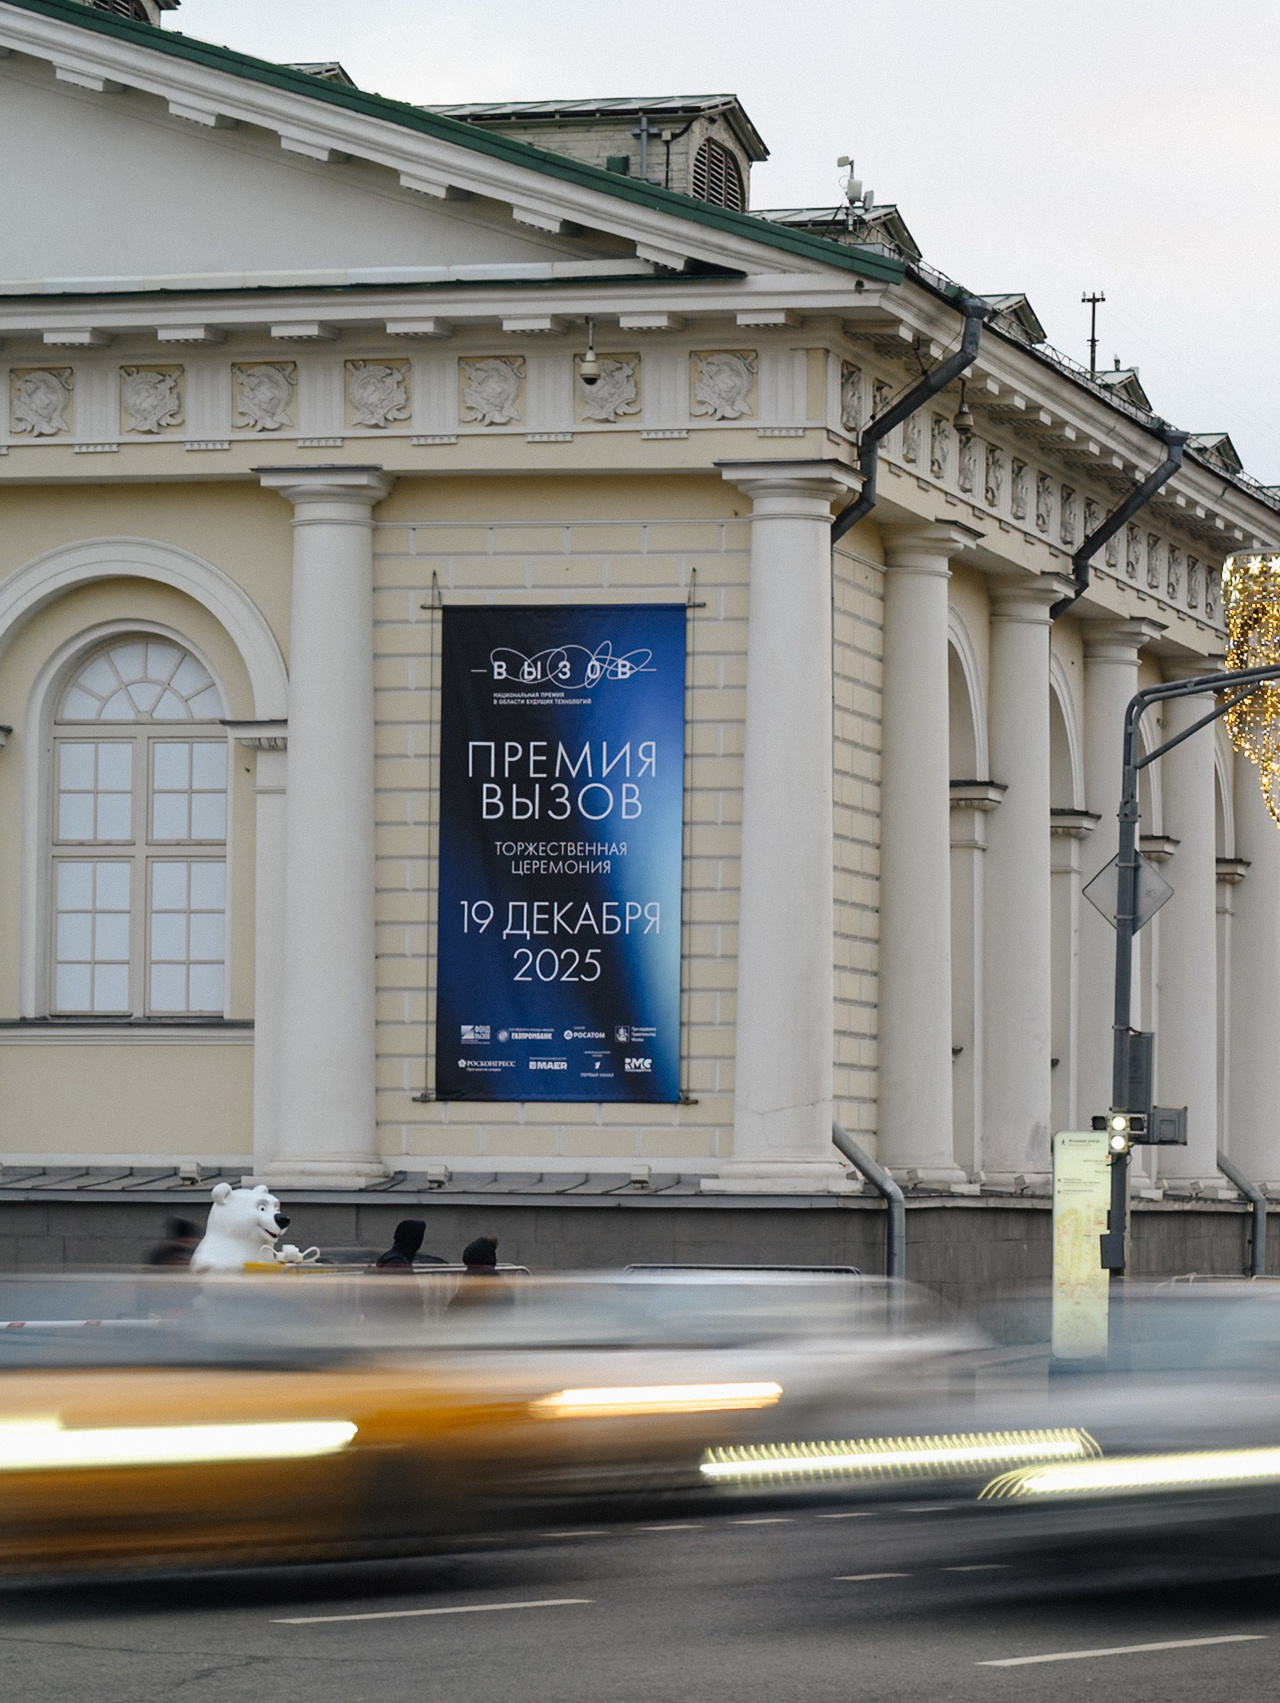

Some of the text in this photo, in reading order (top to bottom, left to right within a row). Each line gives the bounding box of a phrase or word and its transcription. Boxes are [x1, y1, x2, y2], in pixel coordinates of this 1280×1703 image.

[493, 660, 632, 680] ВЫЗОВ
[554, 697, 592, 705] ТЕХНОЛОГИЙ
[468, 741, 656, 778] ПРЕМИЯ
[482, 783, 643, 820] ВЫЗОВ
[494, 841, 628, 856] ТОРЖЕСТВЕННАЯ
[511, 860, 611, 876] ЦЕРЕМОНИЯ
[460, 900, 660, 940] 19 ДЕКАБРЯ
[513, 948, 602, 982] 2025
[511, 1032, 553, 1040] ГАЗПРОМБАНК
[537, 1061, 568, 1070] MAER
